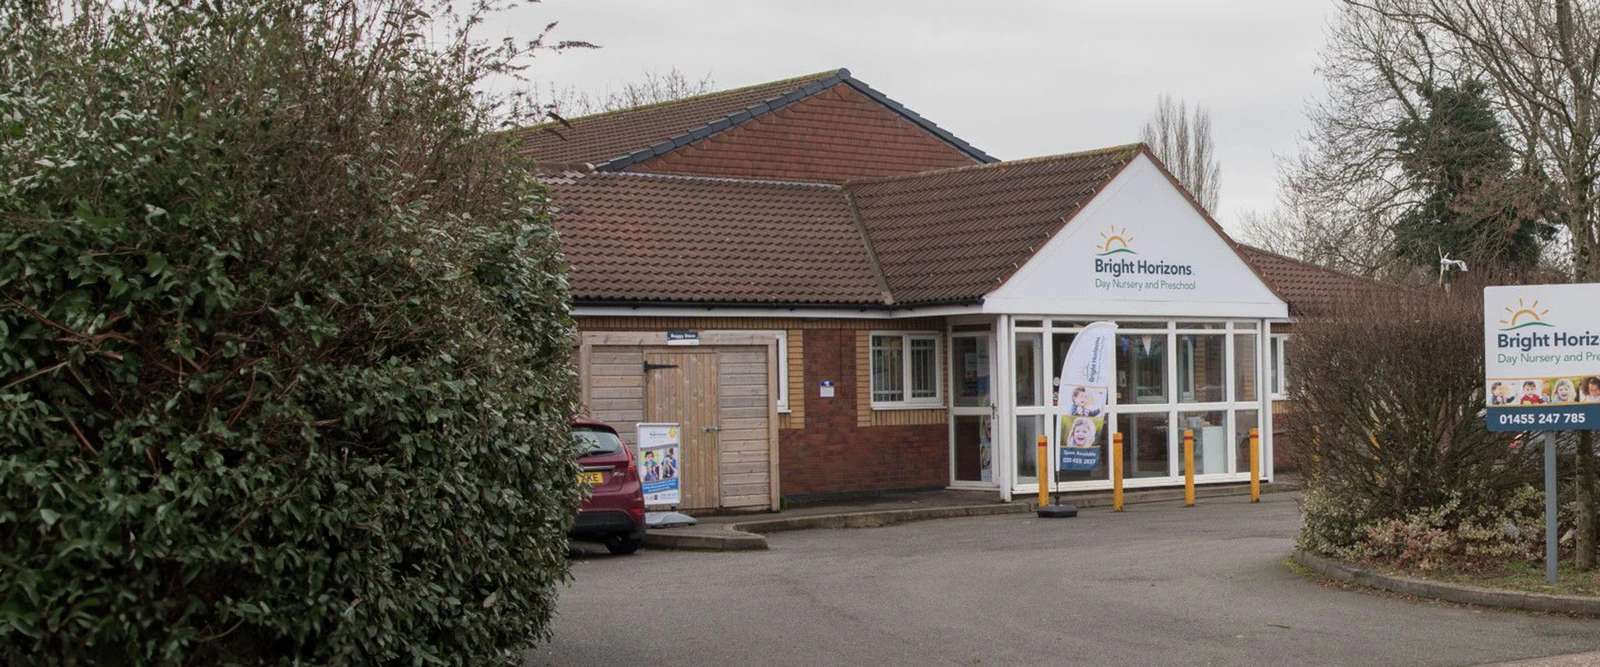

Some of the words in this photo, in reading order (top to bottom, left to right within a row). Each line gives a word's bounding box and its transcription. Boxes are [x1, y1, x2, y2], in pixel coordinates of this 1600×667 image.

[1095, 258, 1135, 277] Bright
[1137, 260, 1192, 275] Horizons
[1095, 278, 1111, 291] Day
[1112, 279, 1142, 291] Nursery
[1144, 280, 1159, 290] and
[1160, 280, 1196, 290] Preschool
[1497, 332, 1550, 352] Bright
[1497, 353, 1518, 366] Day
[1520, 353, 1561, 365] Nursery
[1563, 352, 1583, 362] and
[1499, 413, 1535, 425] 01455
[1538, 413, 1560, 424] 247
[1563, 412, 1586, 424] 785
